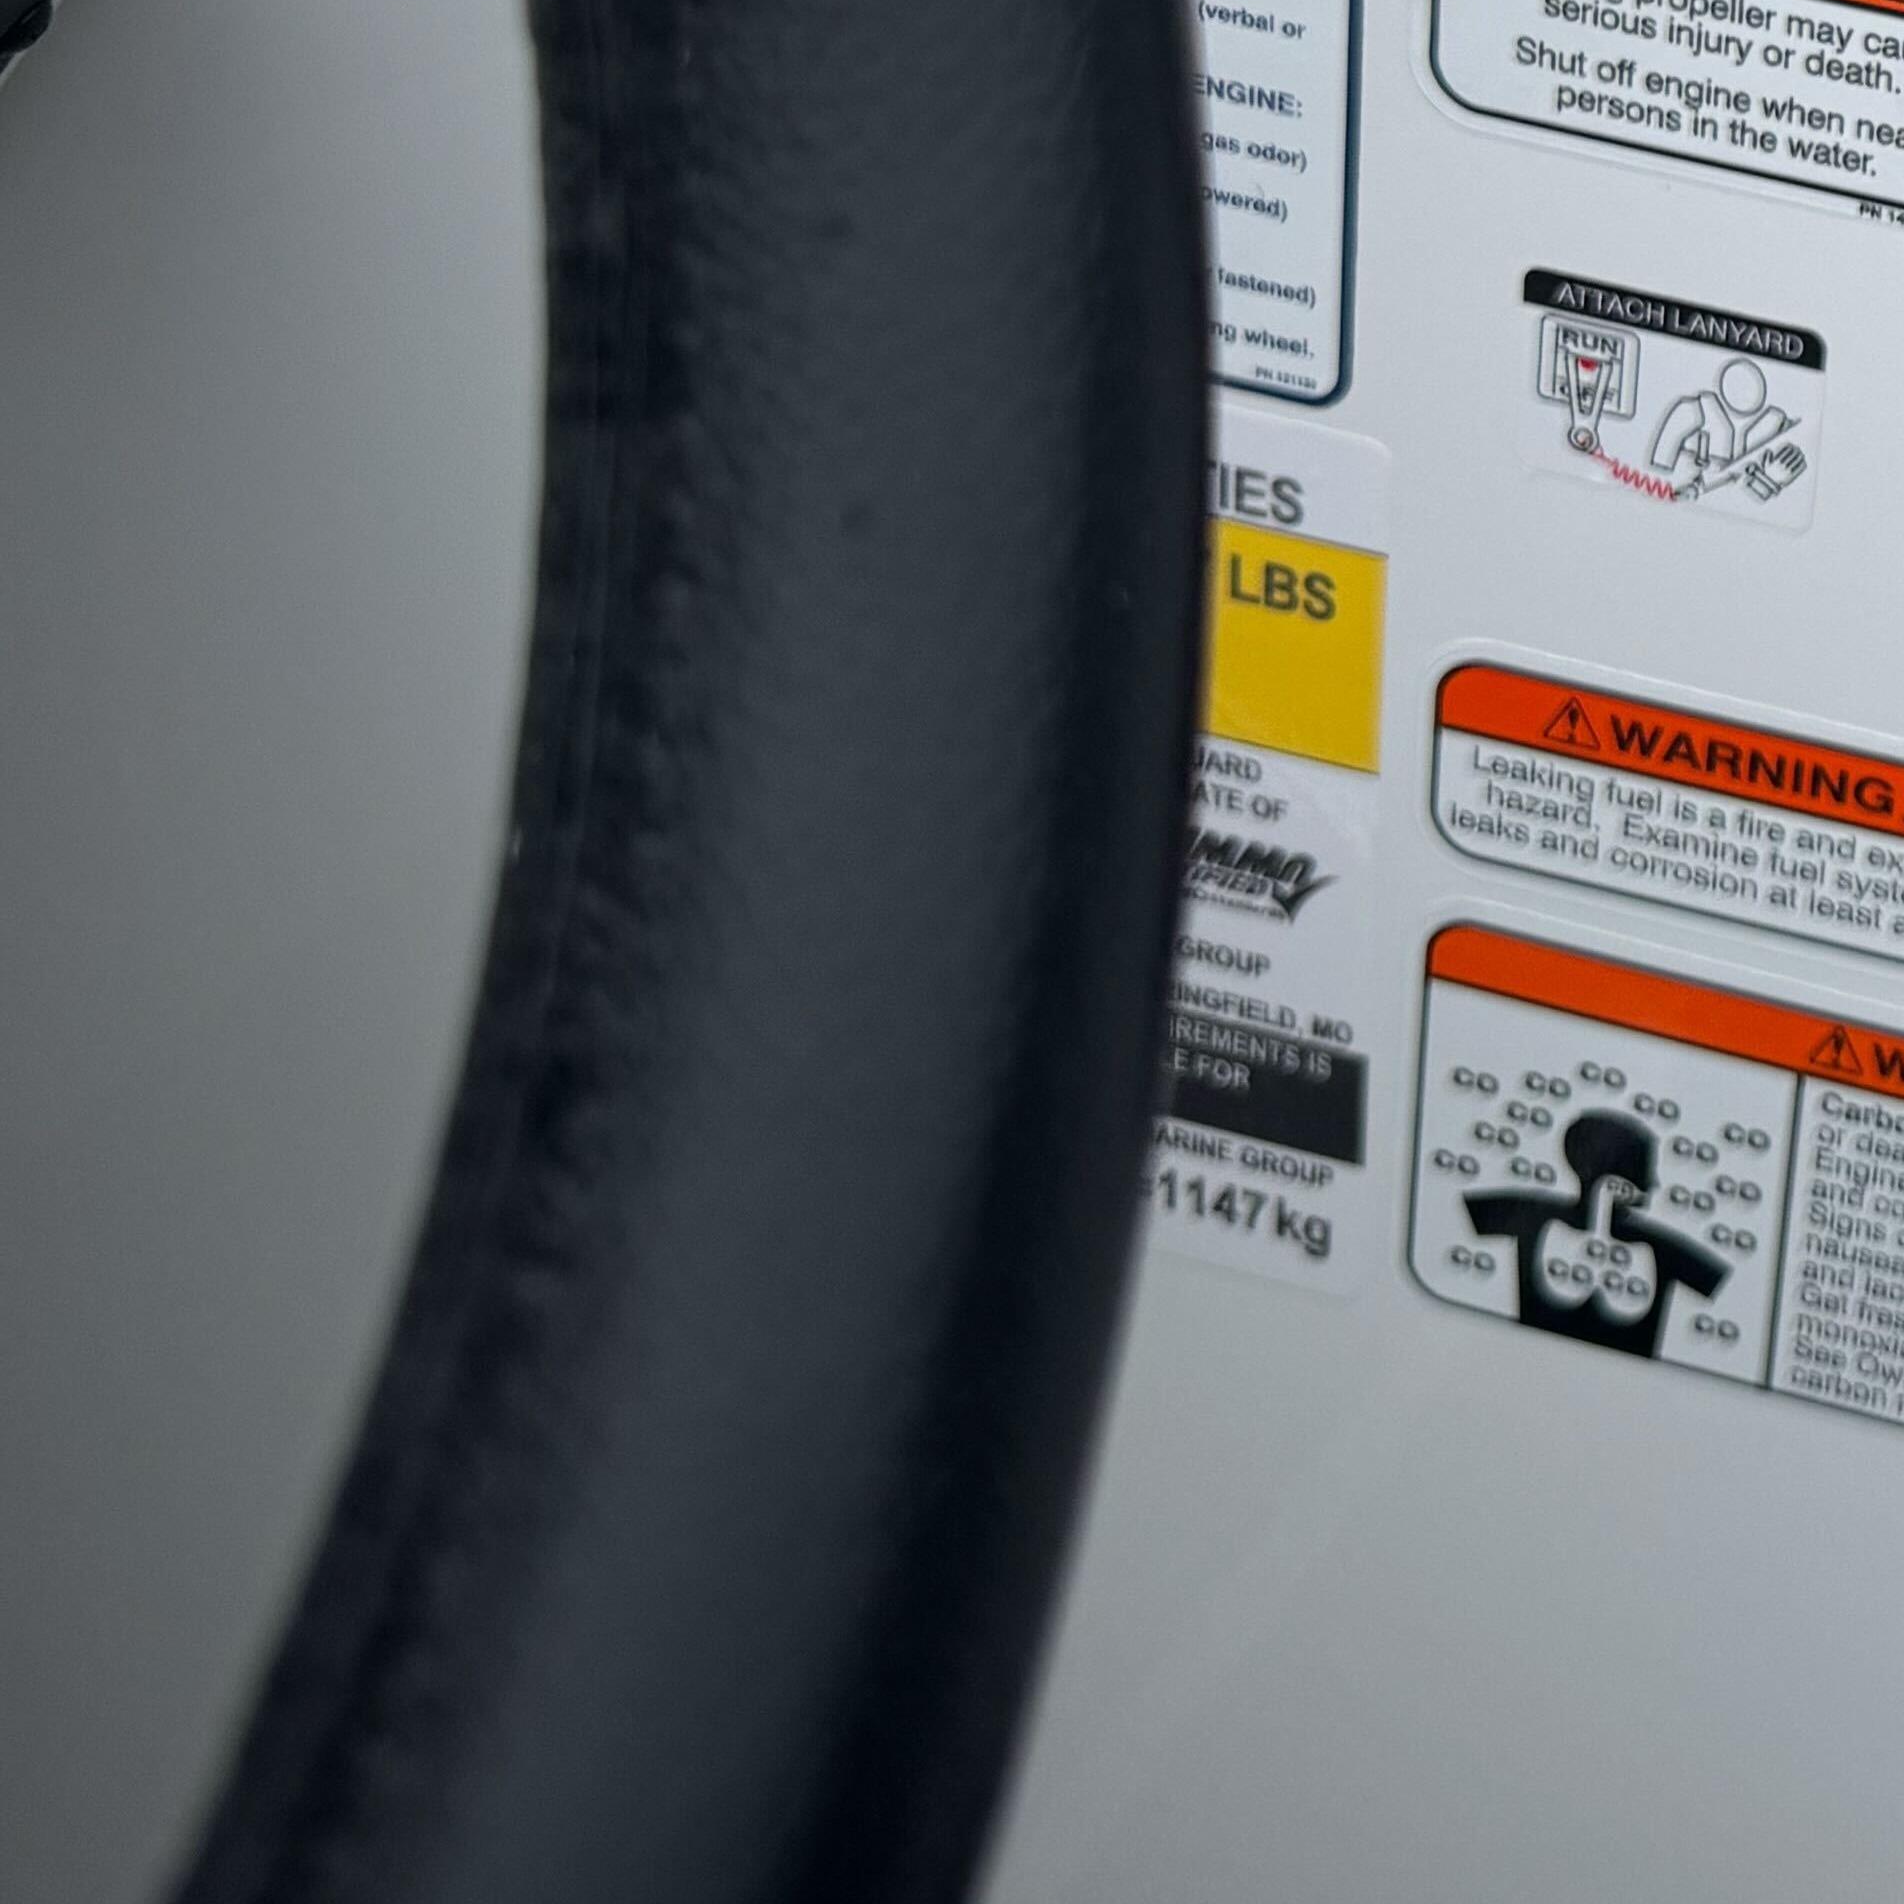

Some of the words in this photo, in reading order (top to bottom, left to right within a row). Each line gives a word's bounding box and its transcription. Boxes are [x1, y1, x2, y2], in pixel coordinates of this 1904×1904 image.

[1198, 0, 1274, 34] (verbal
[1282, 20, 1305, 39] or
[1786, 13, 1851, 57] may
[1668, 19, 1752, 68] injury
[1763, 43, 1796, 70] or
[1805, 49, 1903, 95] death.
[1515, 36, 1587, 79] Shut
[1596, 53, 1636, 89] off
[1645, 67, 1751, 121] engine
[1762, 92, 1845, 136] when
[1201, 130, 1239, 156] gas
[1247, 139, 1307, 173] odor)
[1556, 81, 1681, 136] persons
[1693, 109, 1718, 141] in
[1728, 117, 1777, 155] the
[1787, 134, 1877, 178] water.
[1200, 184, 1288, 223] owered)
[1859, 201, 1881, 219] PN
[1218, 268, 1316, 309] fastened)
[1557, 281, 1665, 324] ATTACH
[1674, 309, 1804, 359] LANYARD
[1561, 327, 1618, 355] RUN
[1228, 553, 1337, 622] LBS
[1609, 714, 1896, 816] WARNING
[1251, 794, 1288, 823] OF
[1471, 745, 1595, 803] Leaking
[1606, 778, 1661, 816] fuel
[1674, 795, 1698, 824] is
[1708, 806, 1726, 830] a
[1738, 808, 1785, 846] fire
[1797, 824, 1855, 861] and
[1486, 780, 1600, 832] hazard.
[1622, 813, 1758, 868] Examine
[1769, 845, 1825, 885] fuel
[1450, 802, 1530, 845] leaks
[1542, 824, 1599, 861] and
[1611, 841, 1758, 900] corrosion
[1769, 880, 1797, 910] at
[1809, 888, 1881, 930] least
[1173, 980, 1303, 1031] INGFIELD,
[1311, 1014, 1353, 1044] MO
[1168, 1014, 1300, 1071] IREMENTS
[1306, 1049, 1332, 1077] IS
[1197, 1053, 1251, 1089] FOR
[1153, 1122, 1233, 1160] ARINE
[1239, 1144, 1333, 1186] GROUP
[1818, 1123, 1843, 1147] or
[1810, 1176, 1864, 1209] and
[1807, 1199, 1888, 1246] Signs
[1802, 1256, 1855, 1290] and
[1799, 1280, 1849, 1314] Get
[1791, 1364, 1889, 1409] carbon
